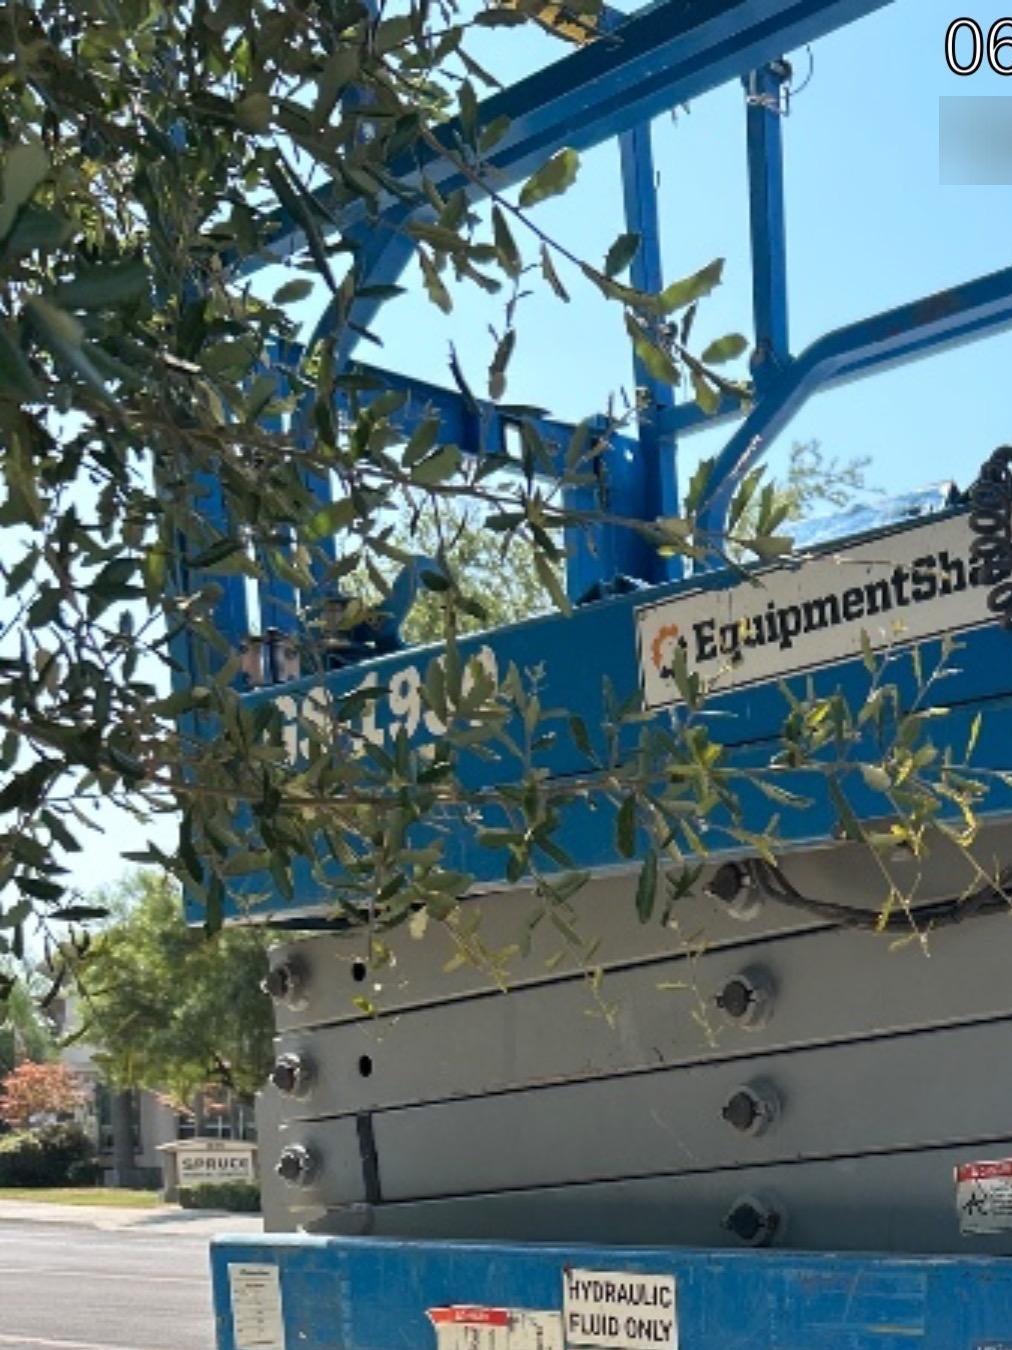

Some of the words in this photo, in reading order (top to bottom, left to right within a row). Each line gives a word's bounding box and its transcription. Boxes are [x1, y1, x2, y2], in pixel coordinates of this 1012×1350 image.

[569, 1280, 672, 1309] HYDRAULIC
[569, 1312, 619, 1337] FLUID
[625, 1316, 672, 1342] ONLY
